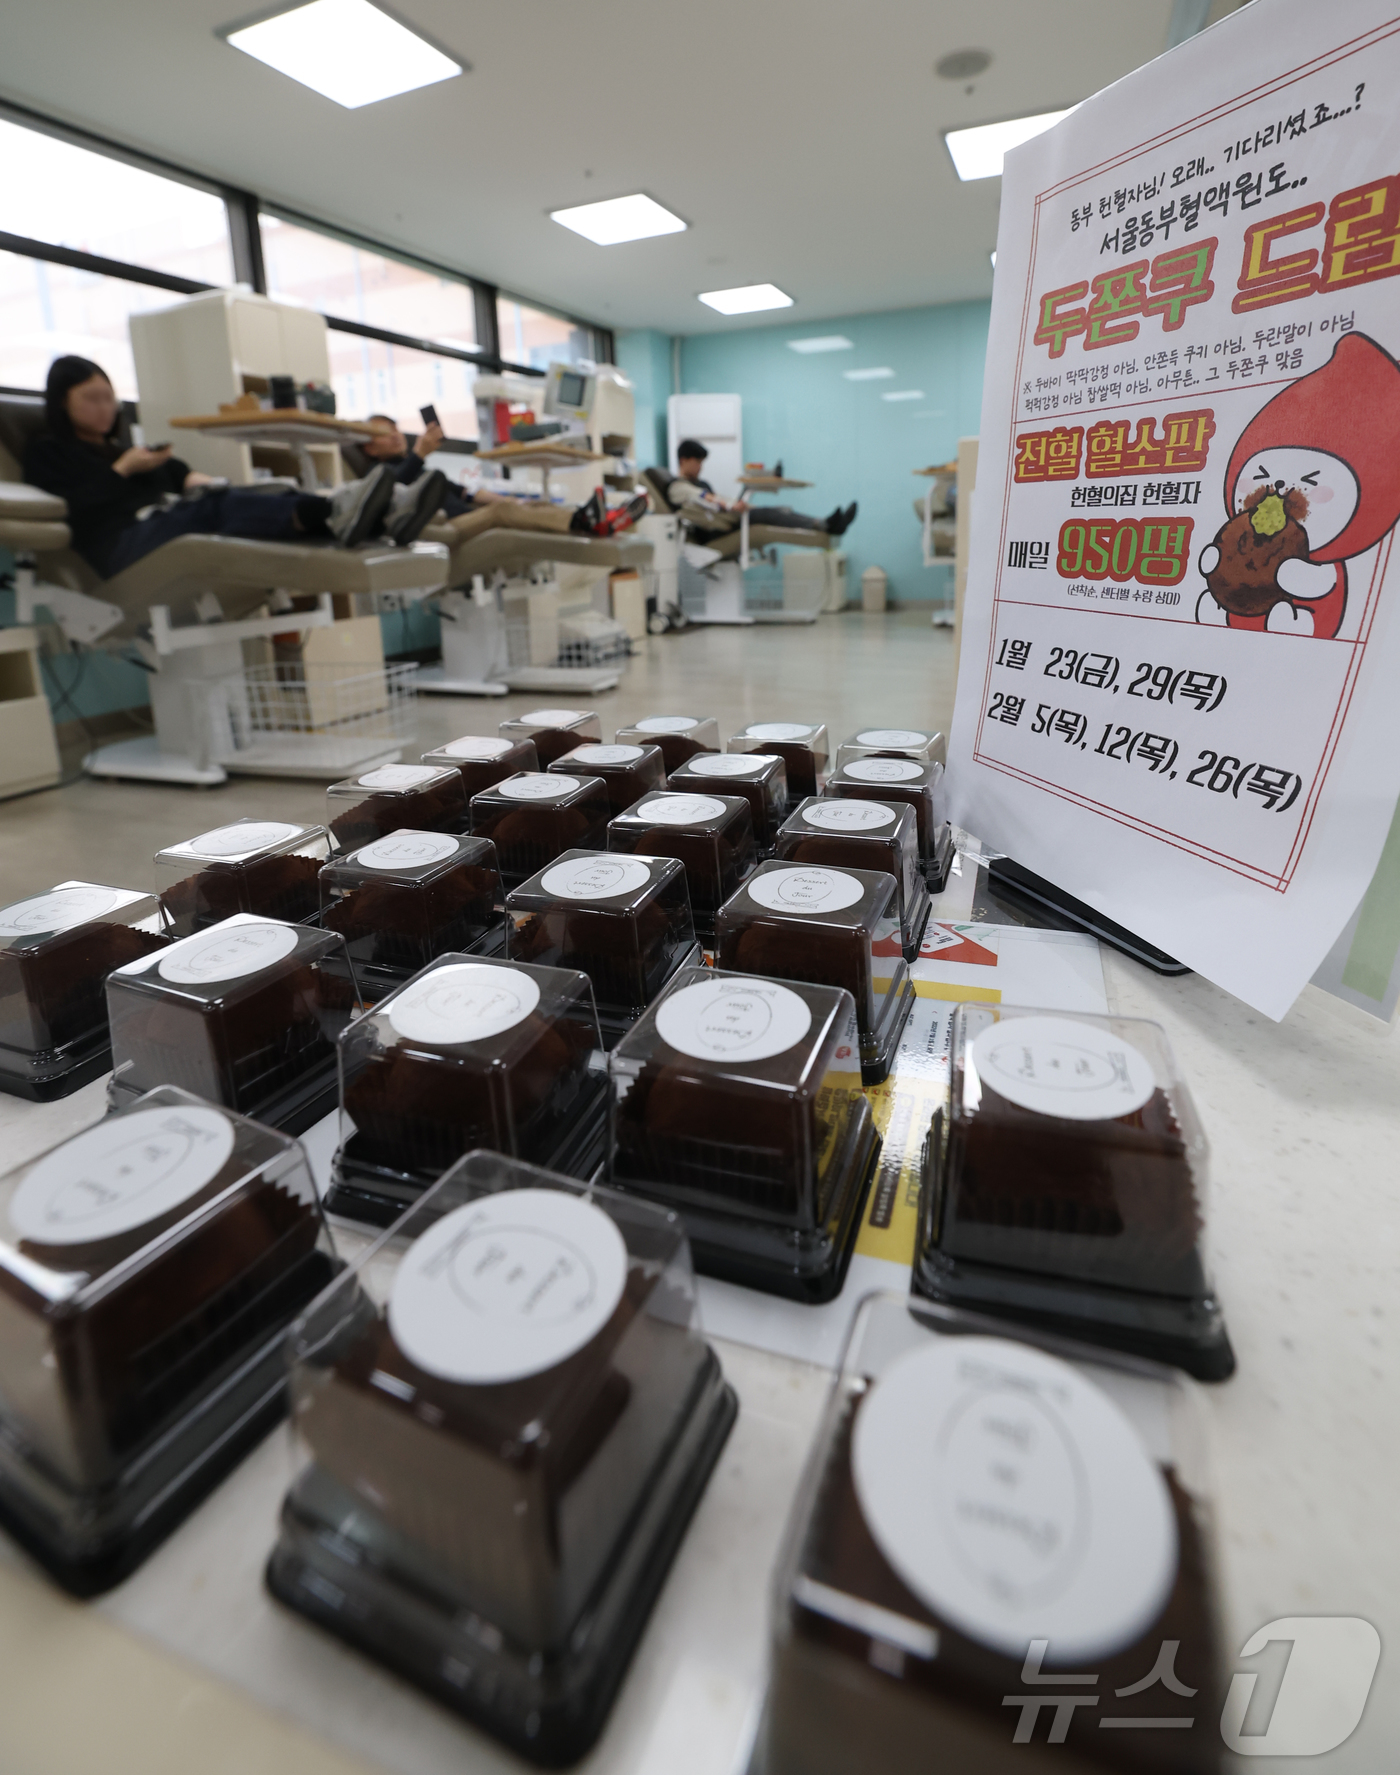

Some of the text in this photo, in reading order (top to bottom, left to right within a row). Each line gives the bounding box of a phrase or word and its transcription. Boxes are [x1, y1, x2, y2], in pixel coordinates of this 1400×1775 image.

[1071, 202, 1093, 232] 동부
[1099, 172, 1165, 219] 헌혈자님!
[1170, 157, 1215, 188] 오래..
[1033, 172, 1400, 359] 두쫀쿠 드림
[1035, 376, 1062, 393] 두바이
[1066, 364, 1110, 386] 딱딱강정
[1144, 349, 1179, 371] 안쫀득
[1183, 344, 1209, 364] 쿠키
[1252, 322, 1312, 350] 두란말이
[1319, 310, 1355, 333] 아님
[1062, 390, 1083, 405] 아님
[1087, 382, 1122, 404] 찹쌀떡
[1205, 367, 1220, 381] 그
[1226, 354, 1269, 380] 두쫀쿠
[1275, 348, 1304, 370] 맞음
[1014, 408, 1216, 483] 전혈 혈소판
[1071, 481, 1201, 508] 헌혈의집 헌혈자
[1007, 517, 1194, 586] 매일 950명
[1067, 584, 1181, 606] (선착순, 센터별 수량 상이)
[995, 638, 1227, 713] 1월 23(금), 29(목)
[987, 692, 1302, 813] 2월 5(목), 12(목), 26(목)
